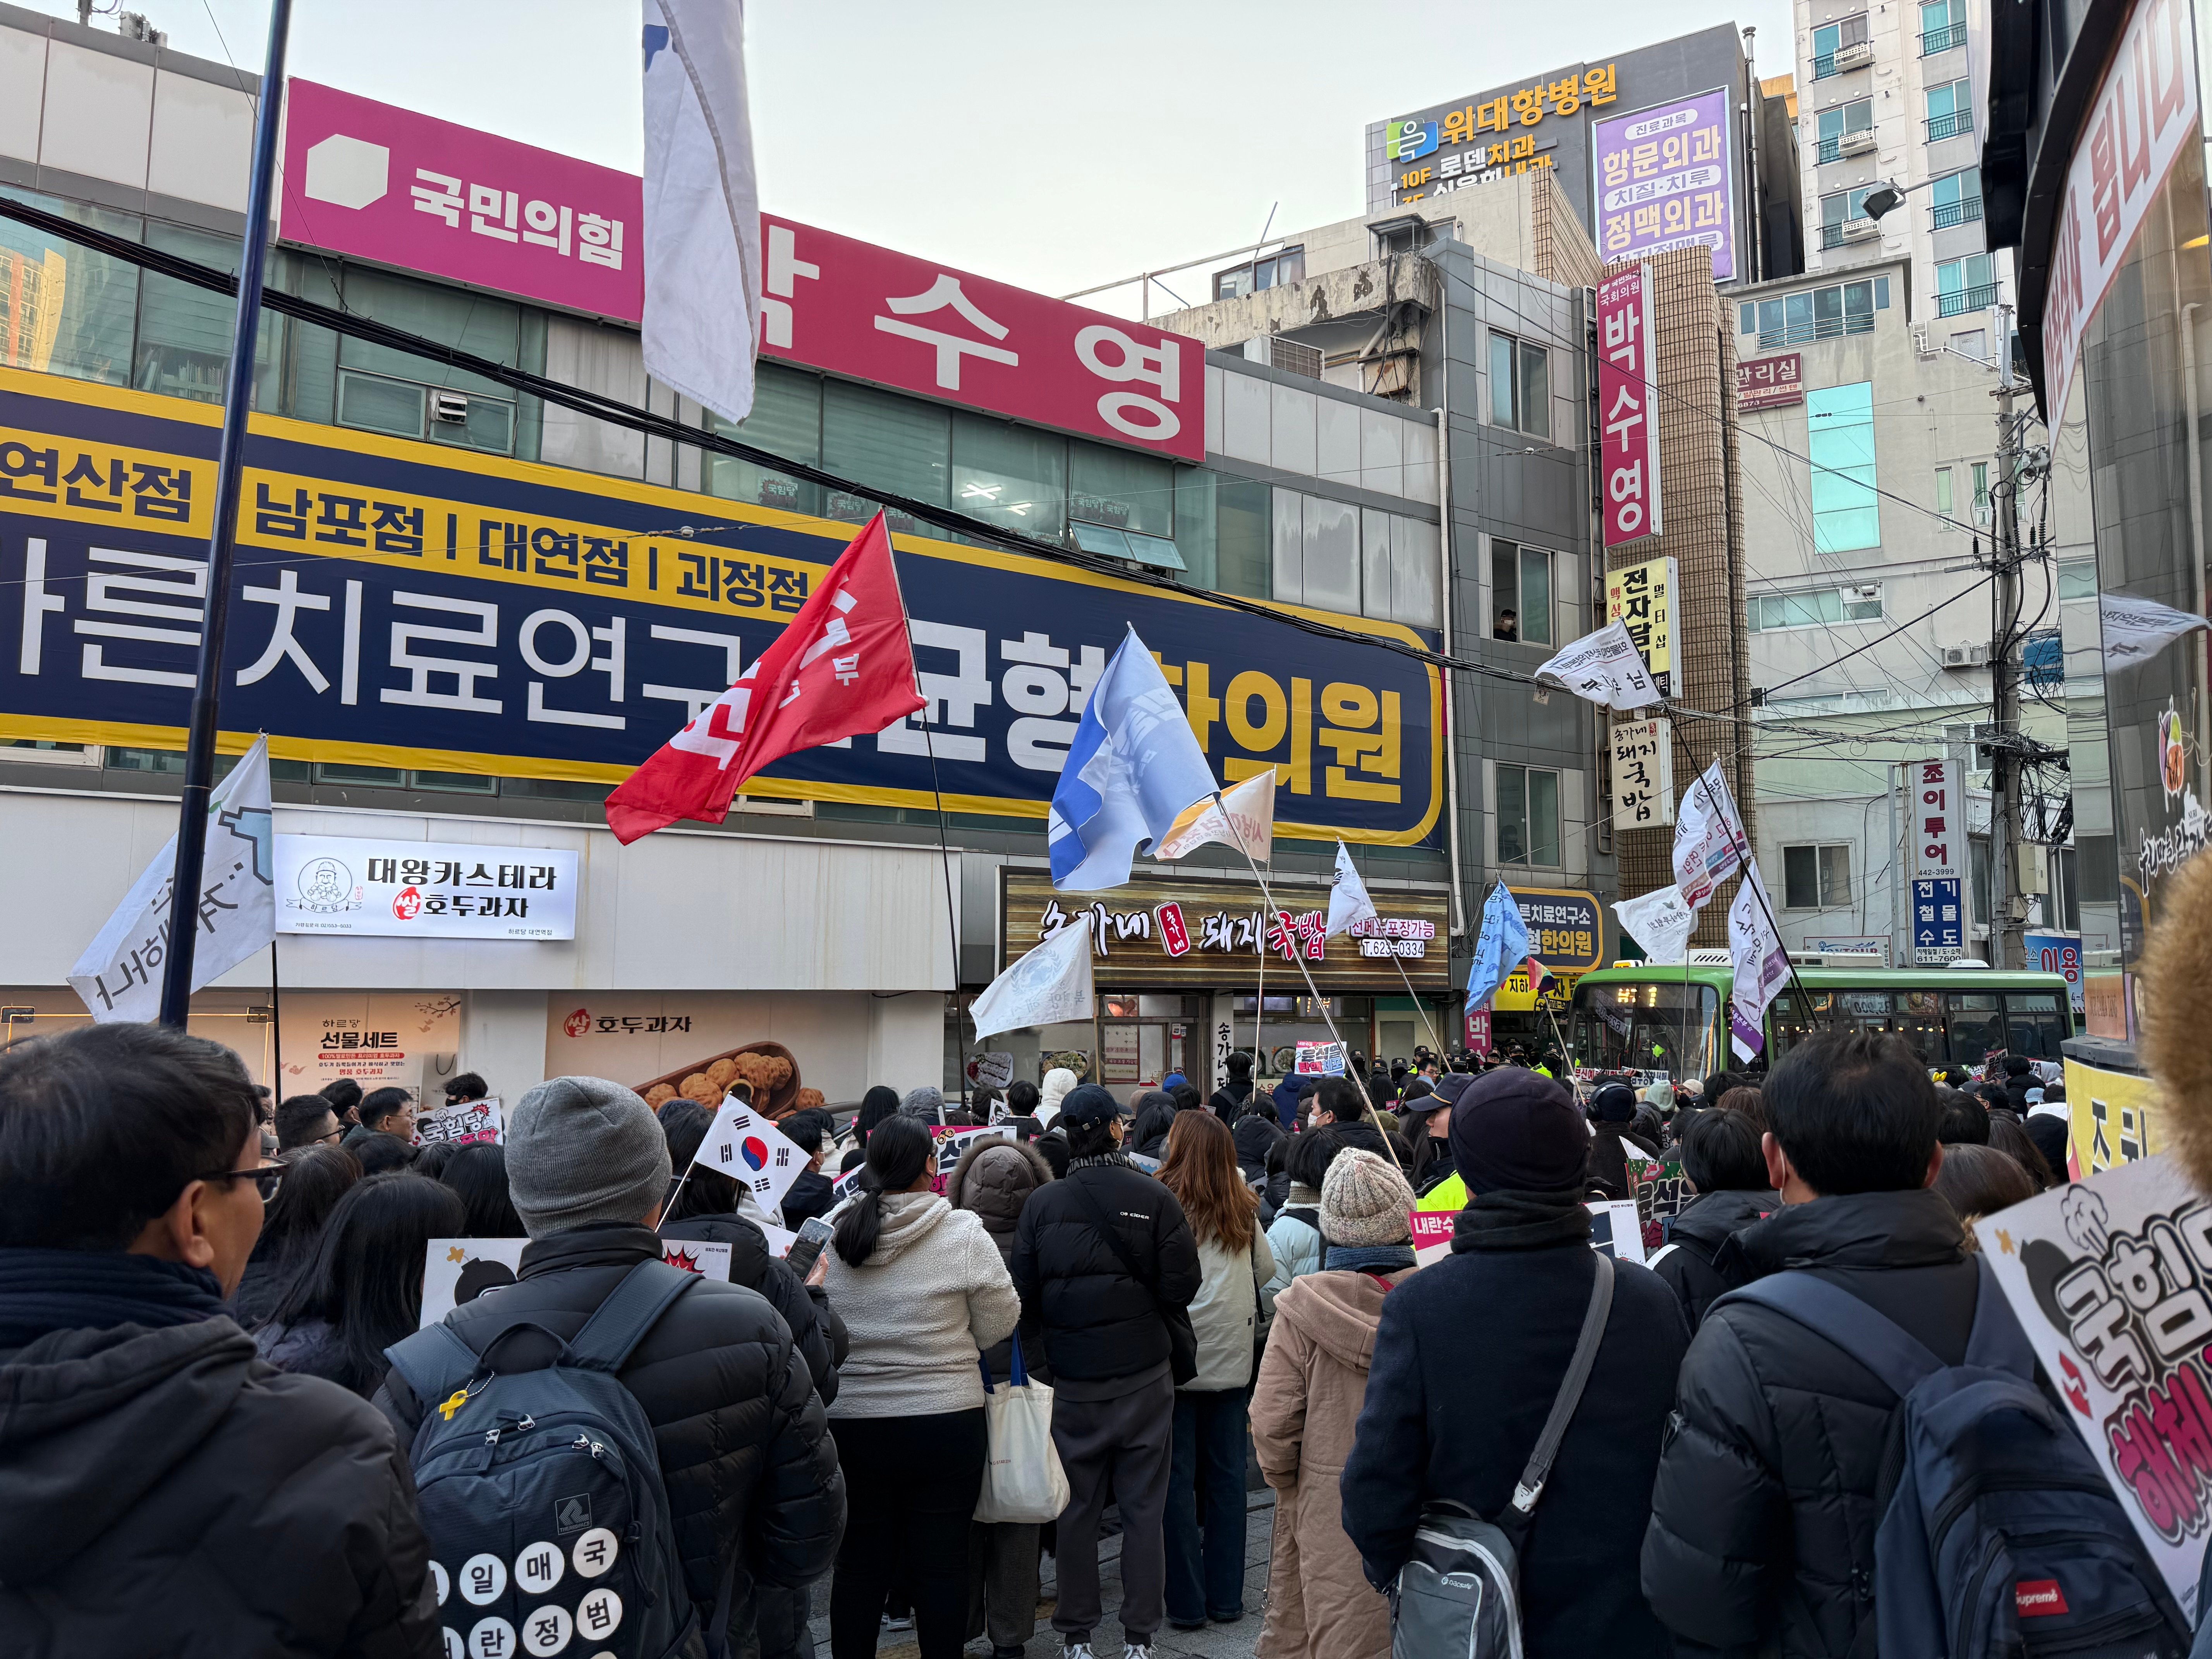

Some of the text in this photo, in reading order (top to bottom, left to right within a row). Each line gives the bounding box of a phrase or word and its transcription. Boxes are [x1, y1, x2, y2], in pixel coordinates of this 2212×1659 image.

[1441, 64, 1618, 145] 위대항병원
[1636, 113, 1686, 136] 진료과목
[1401, 134, 1536, 189] 10F 로덴치과
[1603, 125, 1721, 187] 항문외과
[1614, 169, 1710, 206] 치질·치루
[411, 167, 624, 270] 국민의힘
[1606, 191, 1723, 251] 정맥외과
[1601, 283, 1640, 306] 국회의원
[1605, 304, 1643, 531] 박수영
[0, 441, 191, 523] 연산점
[768, 483, 796, 496] 국힘당
[256, 483, 424, 557] 남포점
[479, 519, 628, 596] 대연점
[676, 551, 808, 612] 괴정점
[1610, 587, 1621, 620] 액상
[1654, 584, 1666, 649] 멀티샵
[20, 538, 775, 741] 른치료연구
[1614, 726, 1647, 741] 송가네
[1923, 763, 1948, 865] 조이투어
[368, 858, 557, 890] 대왕카스테라
[424, 895, 529, 917] 호두과자
[1520, 905, 1590, 925] 른치료연구소
[1166, 910, 1185, 951] 송가네
[1364, 940, 1423, 957] T.623-0334
[1527, 929, 1592, 957] 형한의원
[321, 1032, 398, 1049] 선물세트
[323, 1019, 361, 1027] 하르당
[595, 1016, 692, 1034] 호두과자
[423, 1110, 484, 1143] 국힘당
